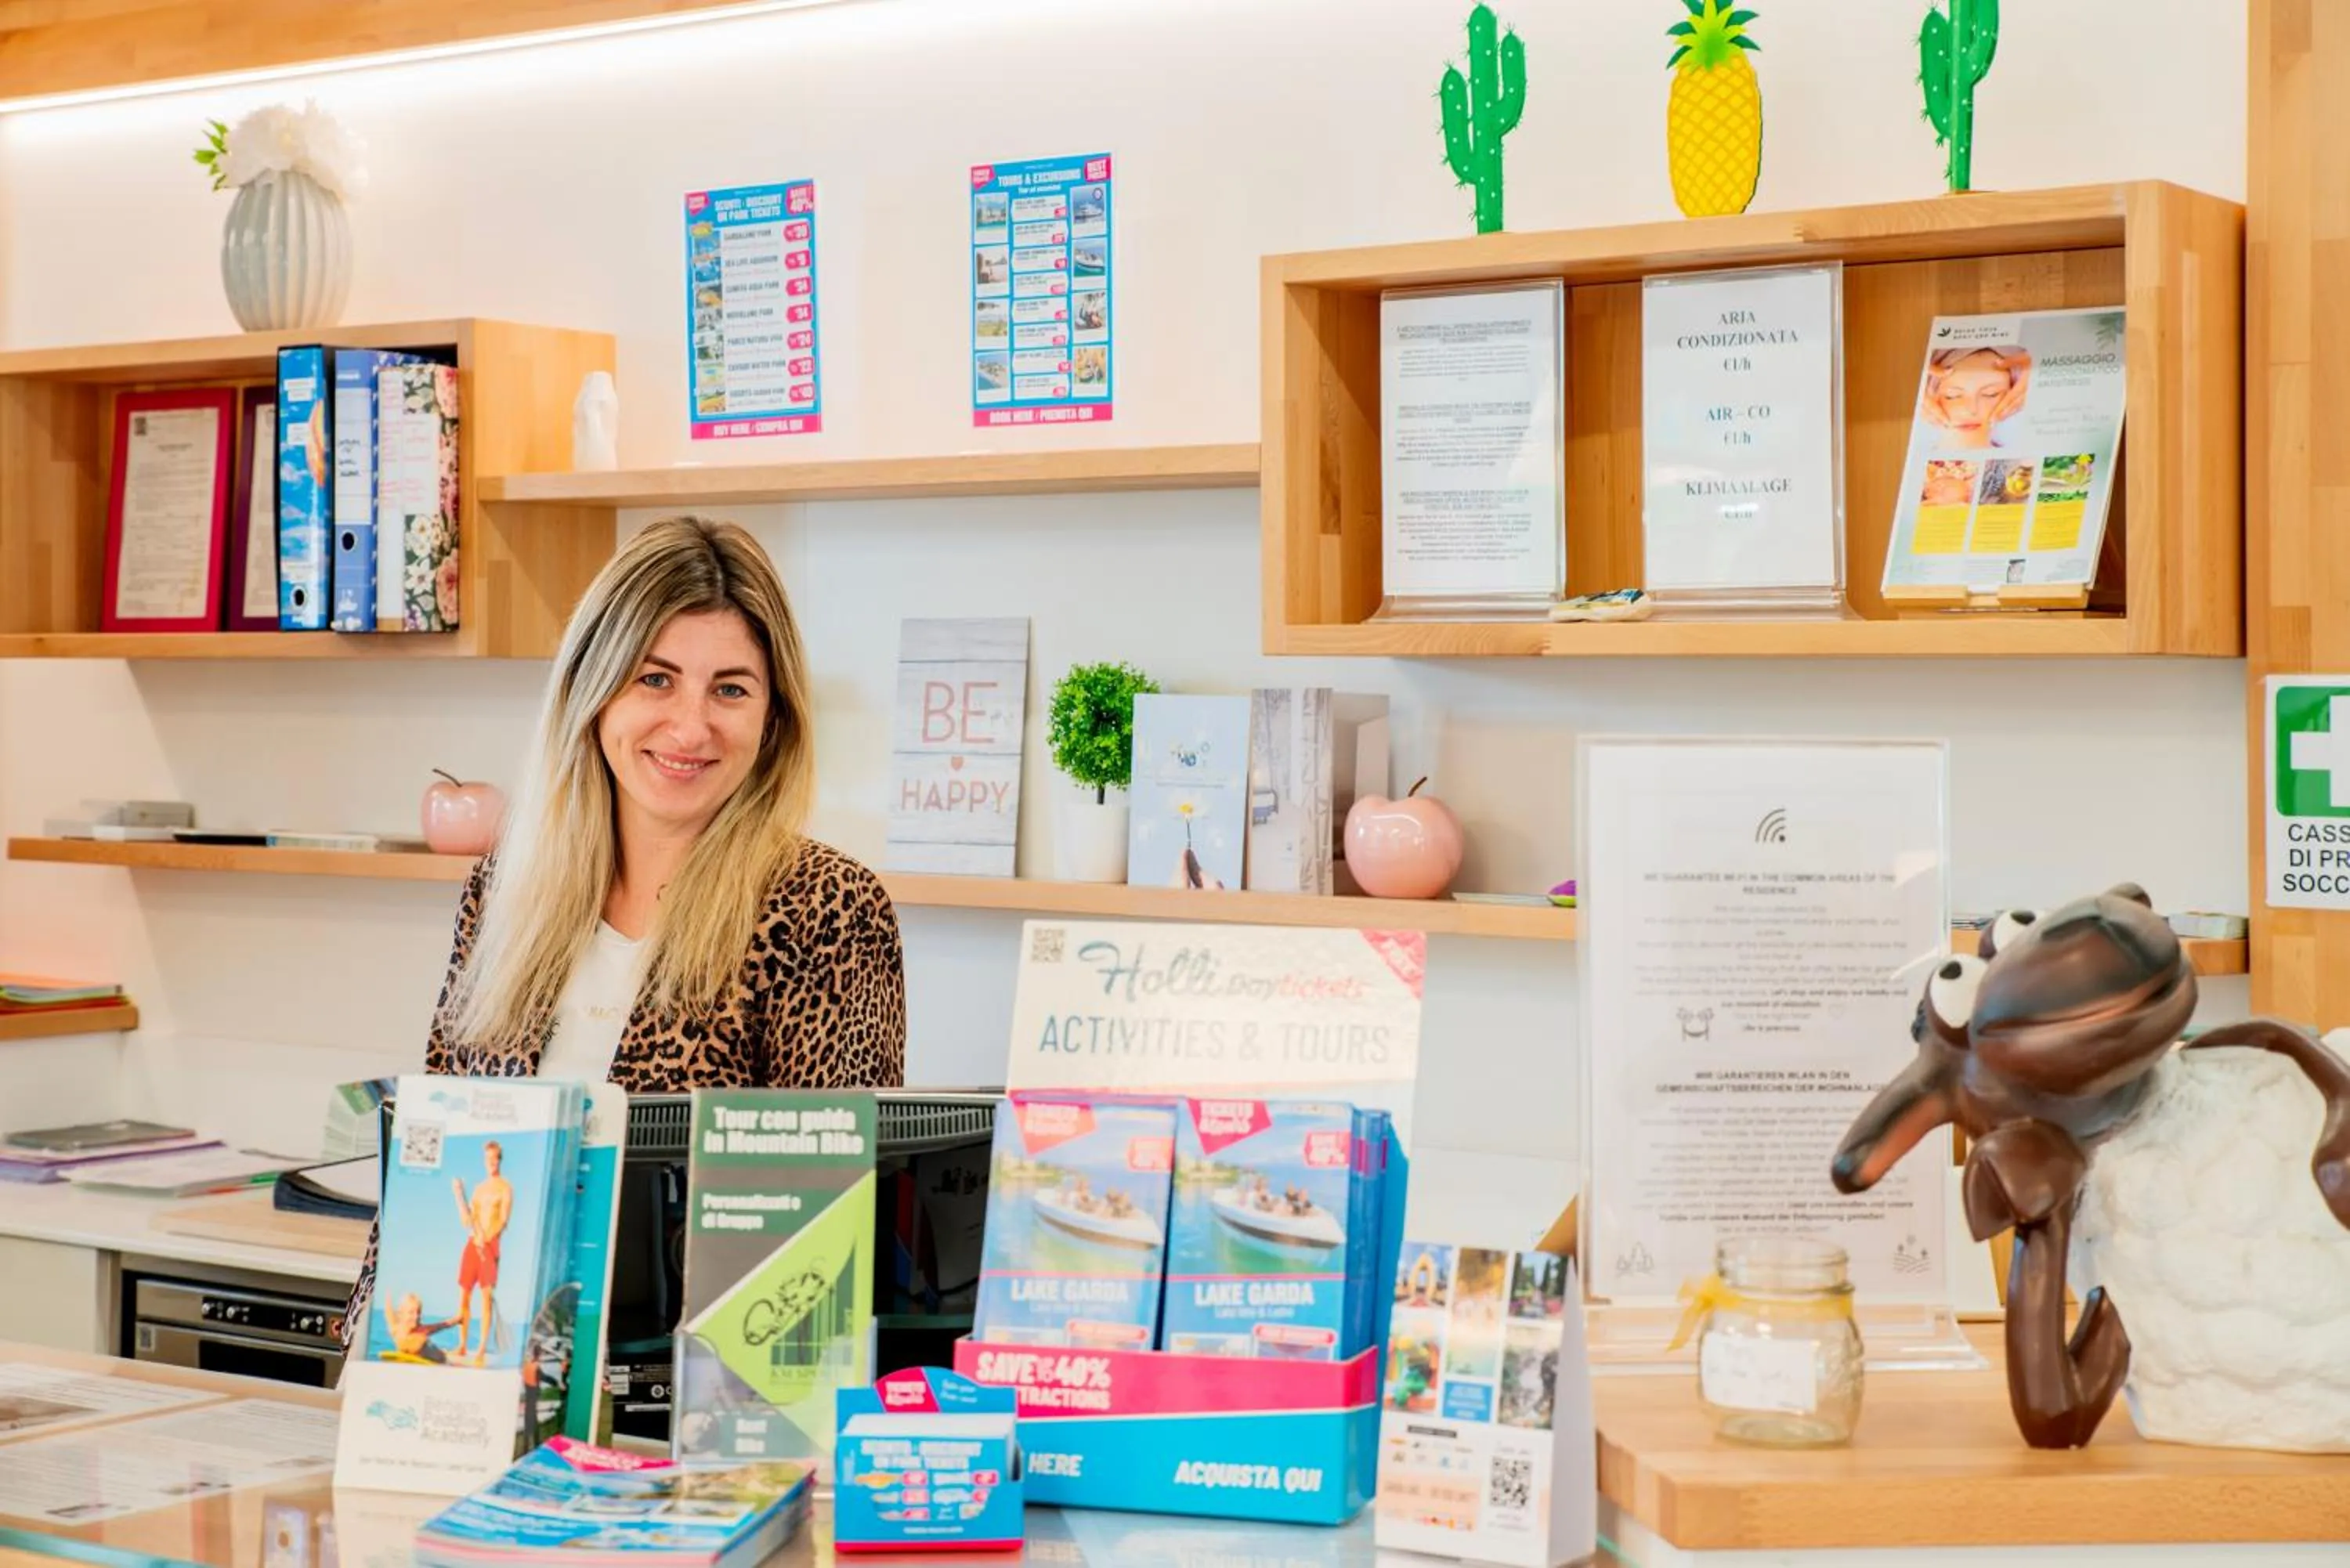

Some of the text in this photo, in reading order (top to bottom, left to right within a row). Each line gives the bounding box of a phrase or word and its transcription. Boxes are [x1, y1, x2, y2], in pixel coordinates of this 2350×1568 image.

[1718, 311, 1755, 325] ARIA
[1677, 329, 1799, 349] CONDIZIONATA
[2041, 352, 2116, 367] MASSAGGIO
[1705, 406, 1733, 421] AIR
[1748, 405, 1770, 420] CO
[922, 681, 998, 745] BE
[901, 778, 1009, 813] HAPPY
[2288, 823, 2350, 843] CASS
[2290, 848, 2310, 867] DI
[2283, 873, 2349, 894] SOCC
[1039, 1014, 1390, 1064] ACTIVITIES & TOURS
[713, 1106, 759, 1130] Tour
[760, 1110, 797, 1131] con
[726, 1130, 819, 1154] Mountain
[820, 1132, 864, 1155] Bike
[1010, 1277, 1129, 1302] LAKE GARDA
[1194, 1281, 1315, 1306] LAKE GARDA
[976, 1351, 1038, 1384] SAVE
[1057, 1355, 1111, 1389] 40%
[1019, 1386, 1111, 1410] TRACTIONS
[1027, 1452, 1083, 1477] HERE
[1174, 1460, 1323, 1494] ACQUISTA QUI
